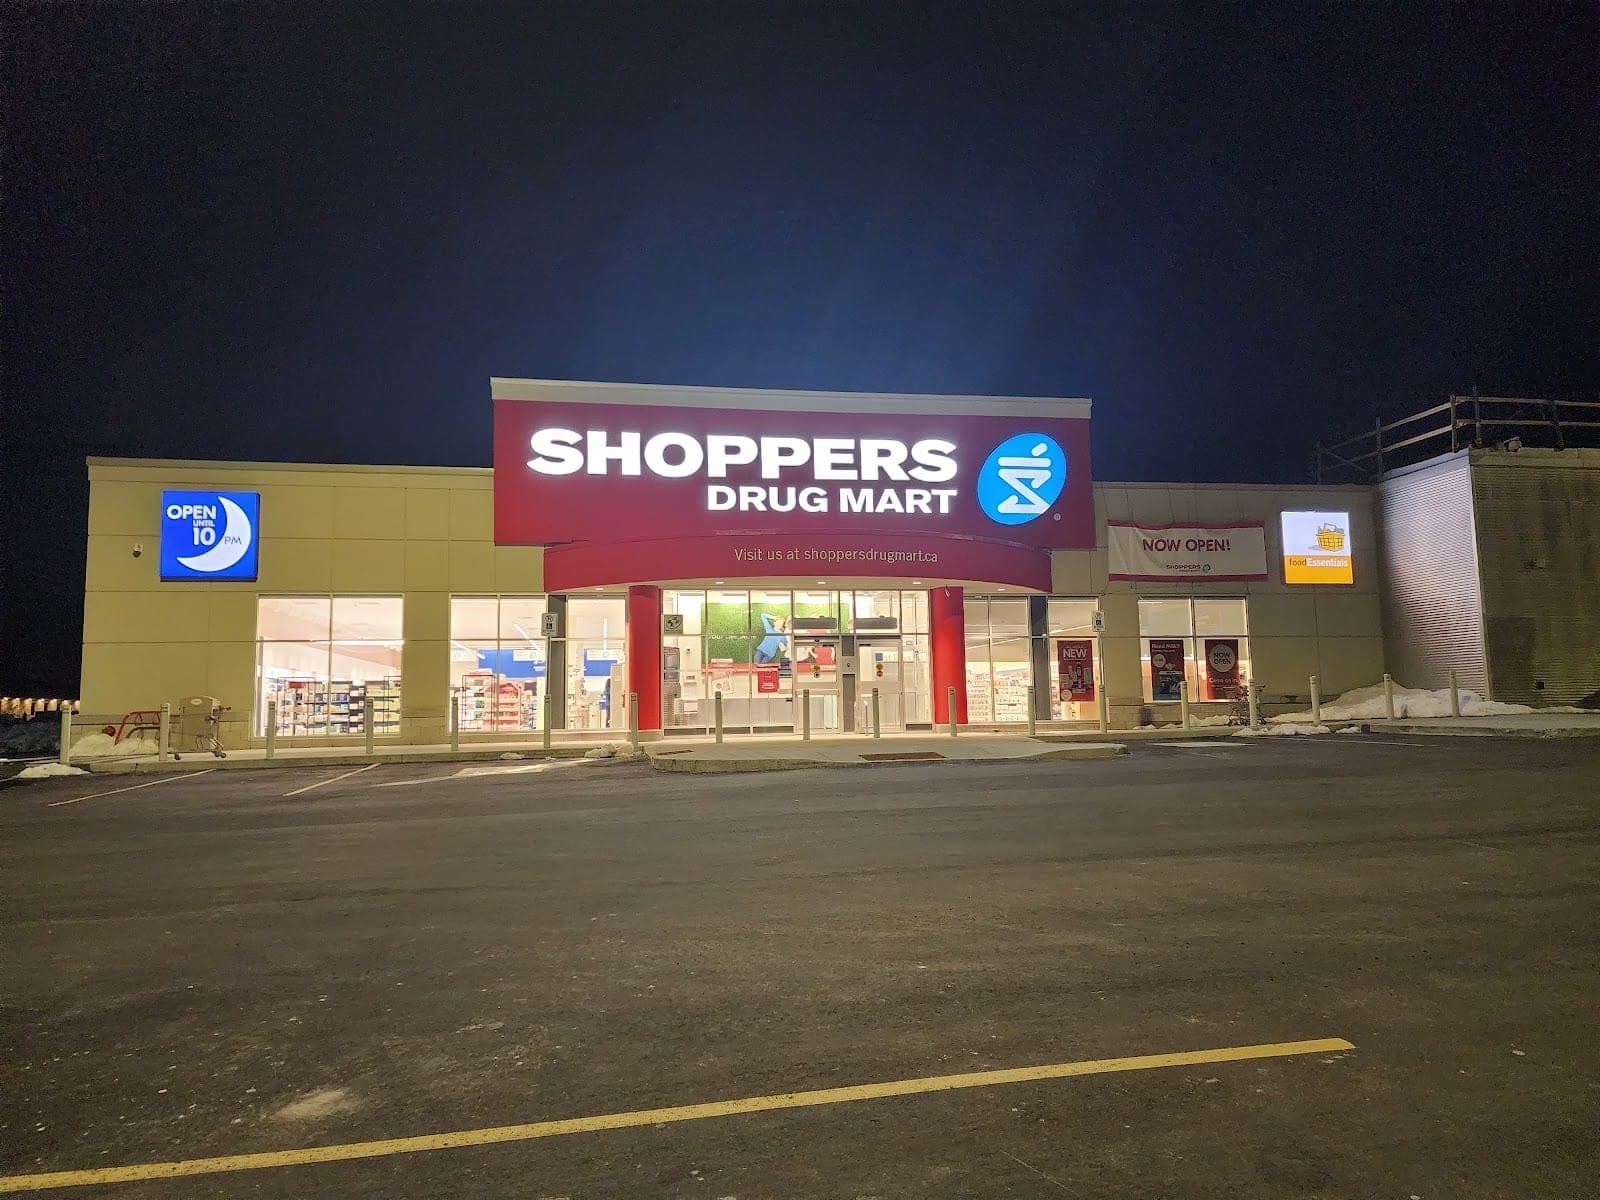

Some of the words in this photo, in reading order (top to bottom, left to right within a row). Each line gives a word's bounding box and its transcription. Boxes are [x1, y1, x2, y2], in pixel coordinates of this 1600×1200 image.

[526, 427, 959, 483] SHOPPERS
[707, 485, 828, 513] DRUG
[839, 487, 959, 514] MART
[166, 504, 217, 520] OPEN
[192, 519, 216, 528] UNTIL
[192, 527, 217, 546] 10
[224, 536, 242, 545] PM
[1142, 538, 1181, 552] NOW
[1185, 538, 1232, 552] OPEN!
[734, 548, 763, 561] Visit
[767, 550, 783, 560] us
[786, 548, 800, 560] at
[803, 548, 938, 564] shoppersdrugmart.ca
[1289, 557, 1349, 567] foodEssentials
[1063, 648, 1088, 658] NEW
